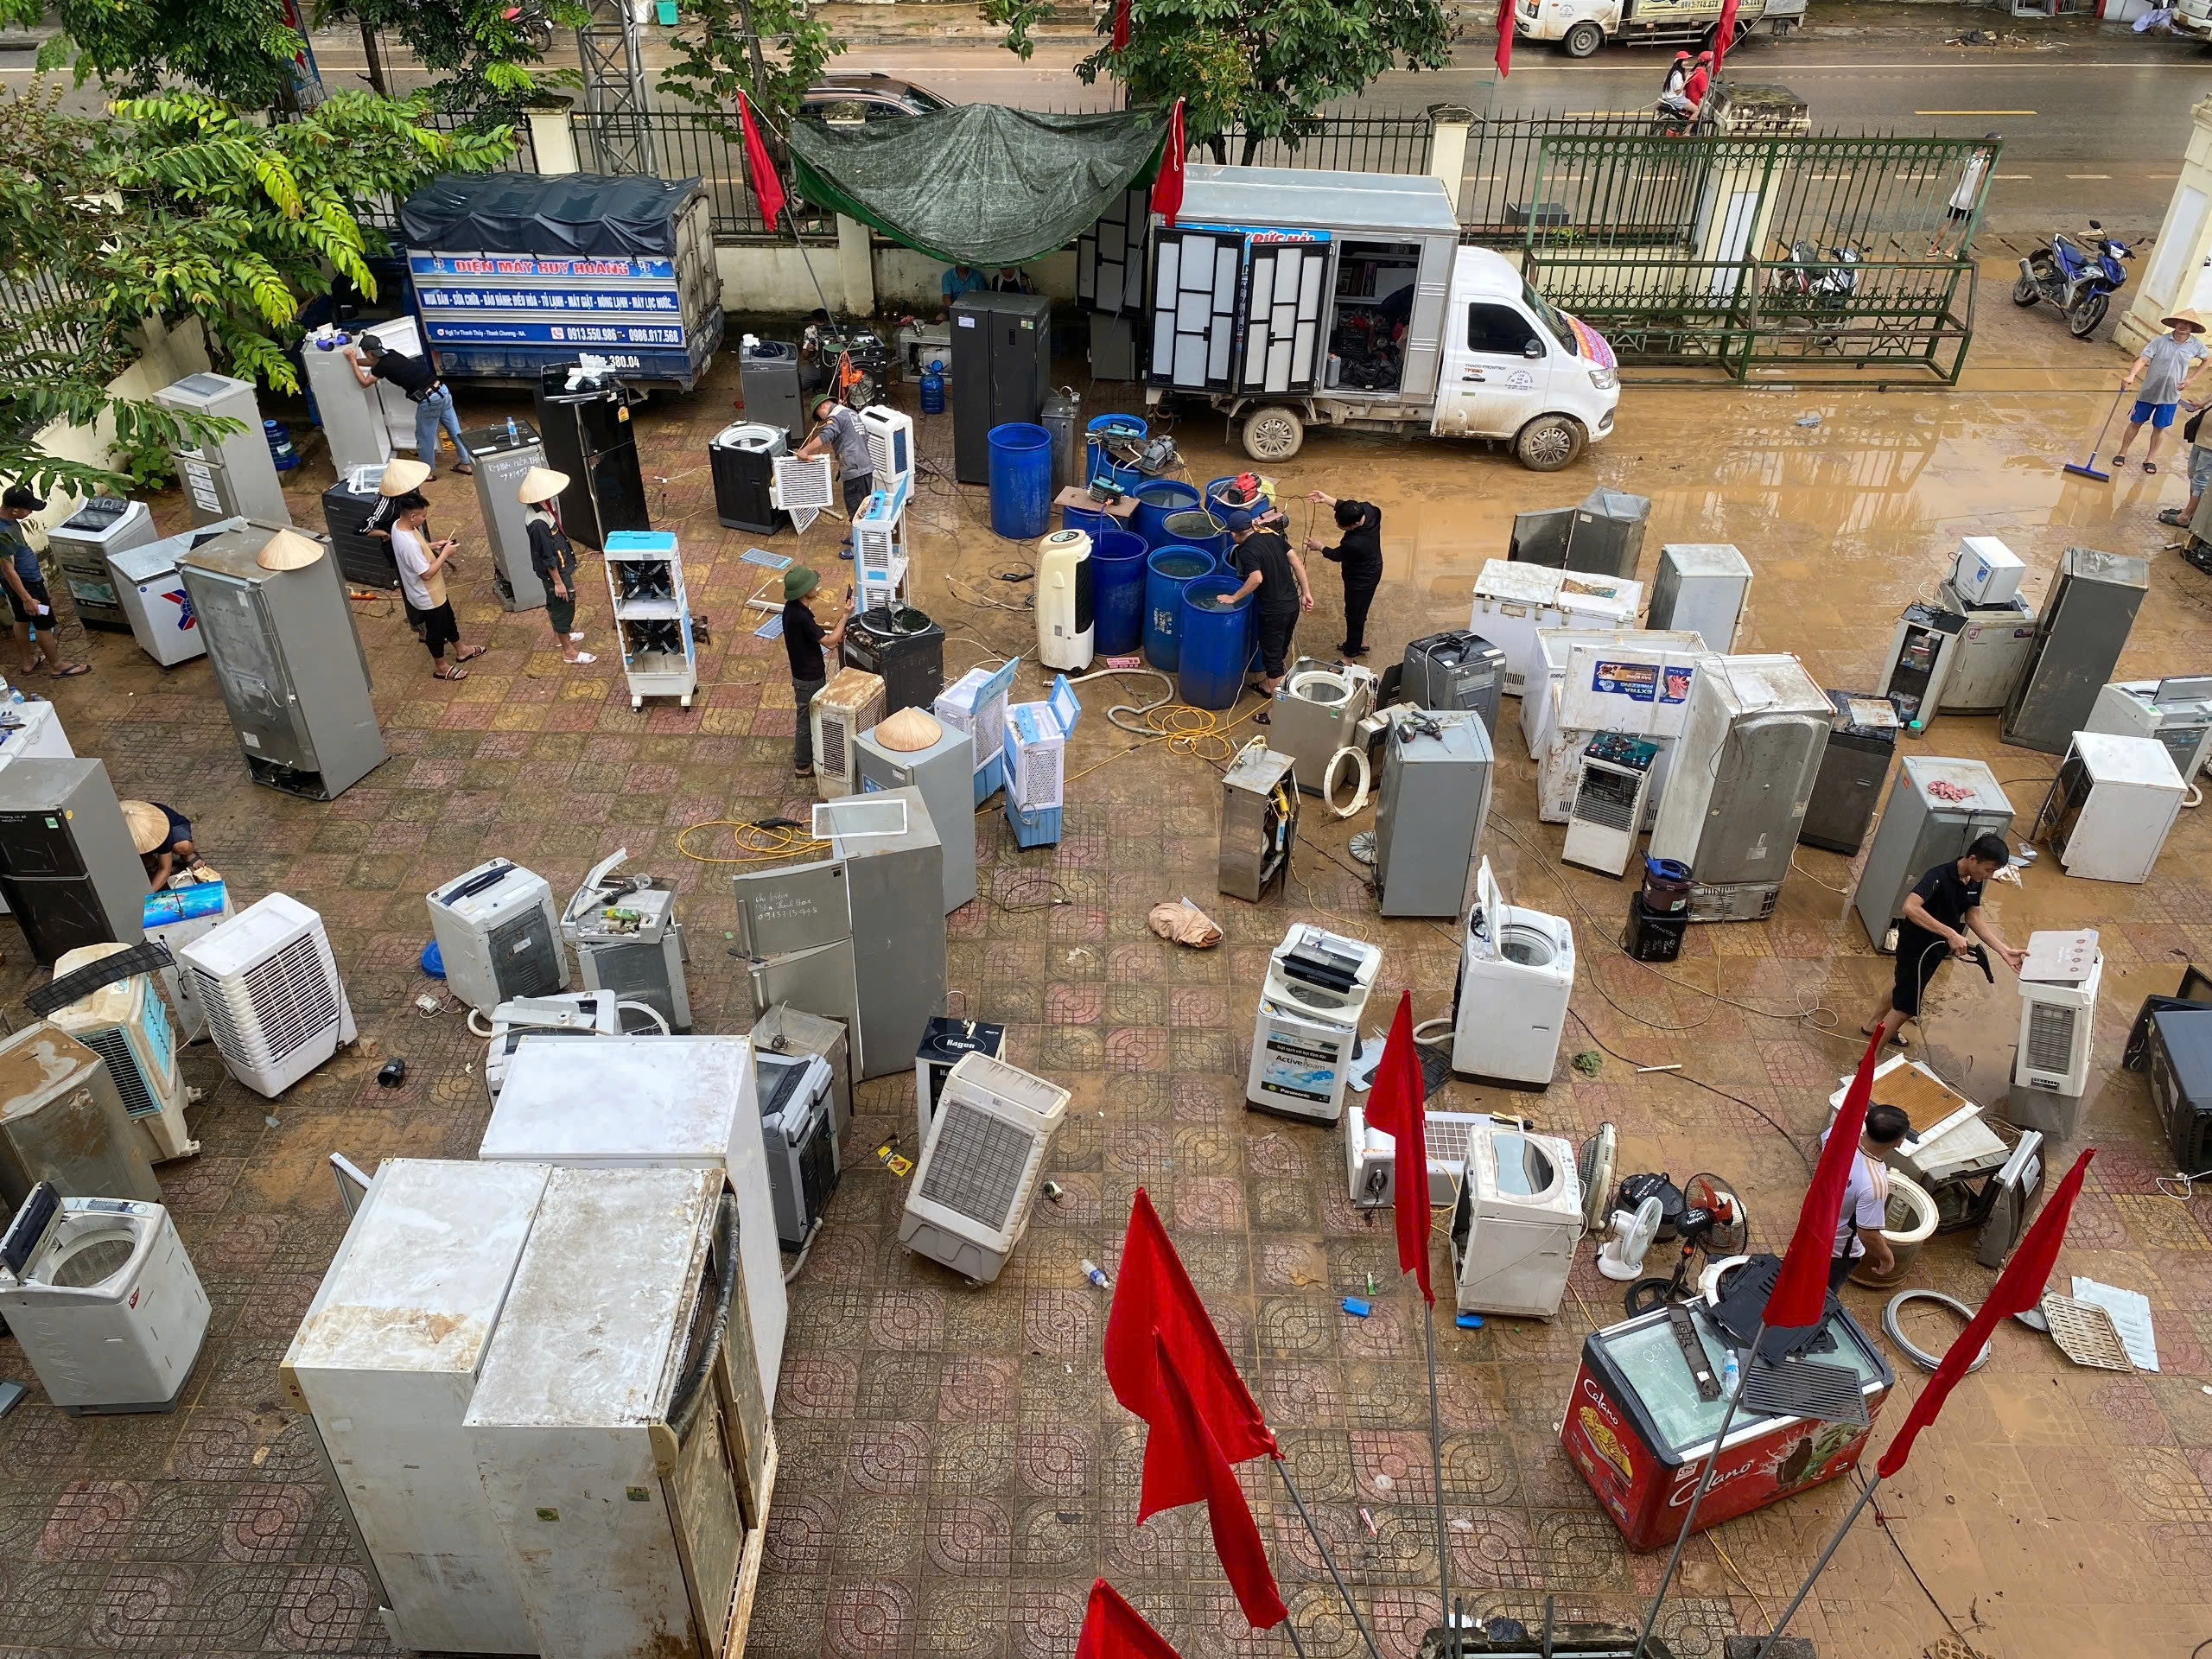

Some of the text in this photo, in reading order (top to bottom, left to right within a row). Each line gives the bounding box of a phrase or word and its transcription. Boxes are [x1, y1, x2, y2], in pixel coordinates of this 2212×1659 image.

[454, 257, 494, 276] ĐIỆN
[498, 259, 533, 274] MÁY
[537, 260, 569, 274] HUY
[567, 327, 678, 343] 0913.550.986 0986.017.568
[1280, 1087, 1310, 1098] Panasonic
[1583, 1378, 1619, 1427] Celano
